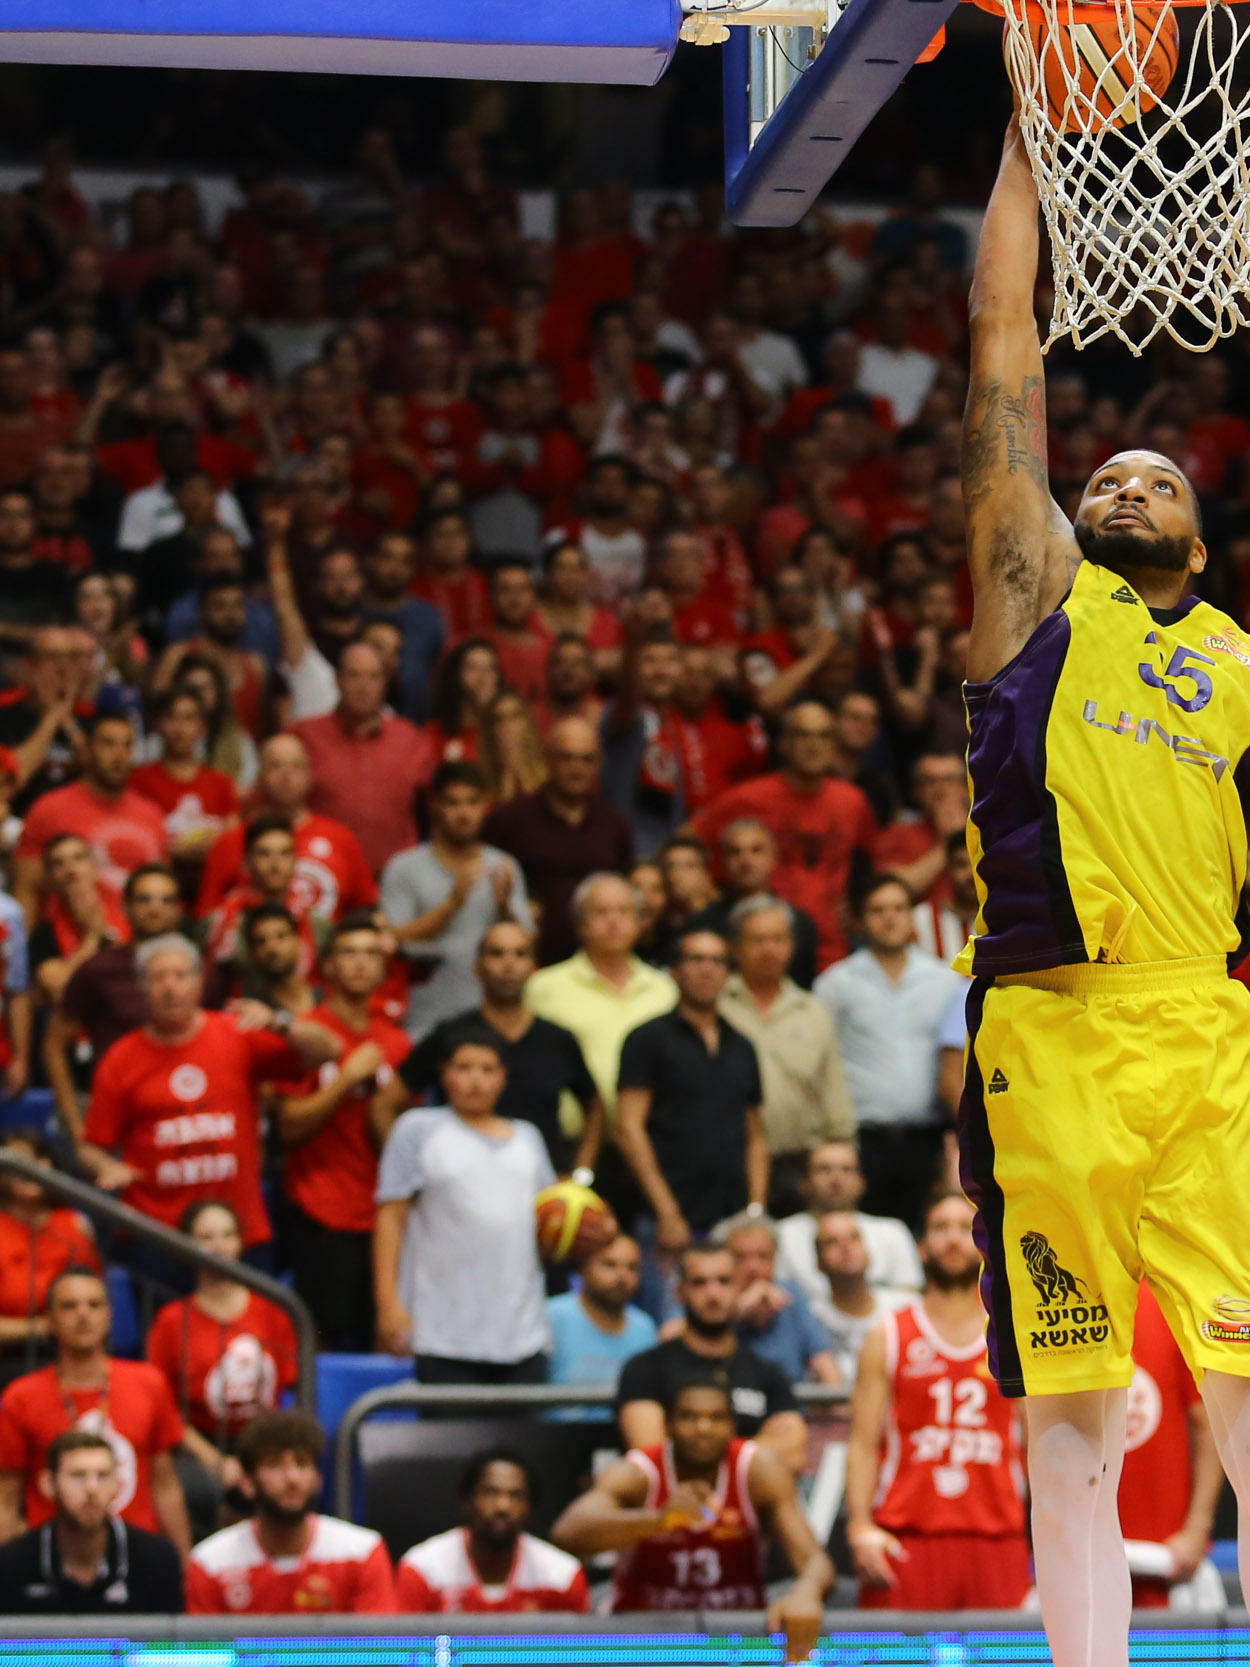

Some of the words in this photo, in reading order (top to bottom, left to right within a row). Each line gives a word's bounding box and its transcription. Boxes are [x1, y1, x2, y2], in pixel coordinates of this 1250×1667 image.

[1036, 1304, 1108, 1327] מסיעי
[1030, 1325, 1108, 1349] שאשא
[928, 1377, 988, 1427] 12
